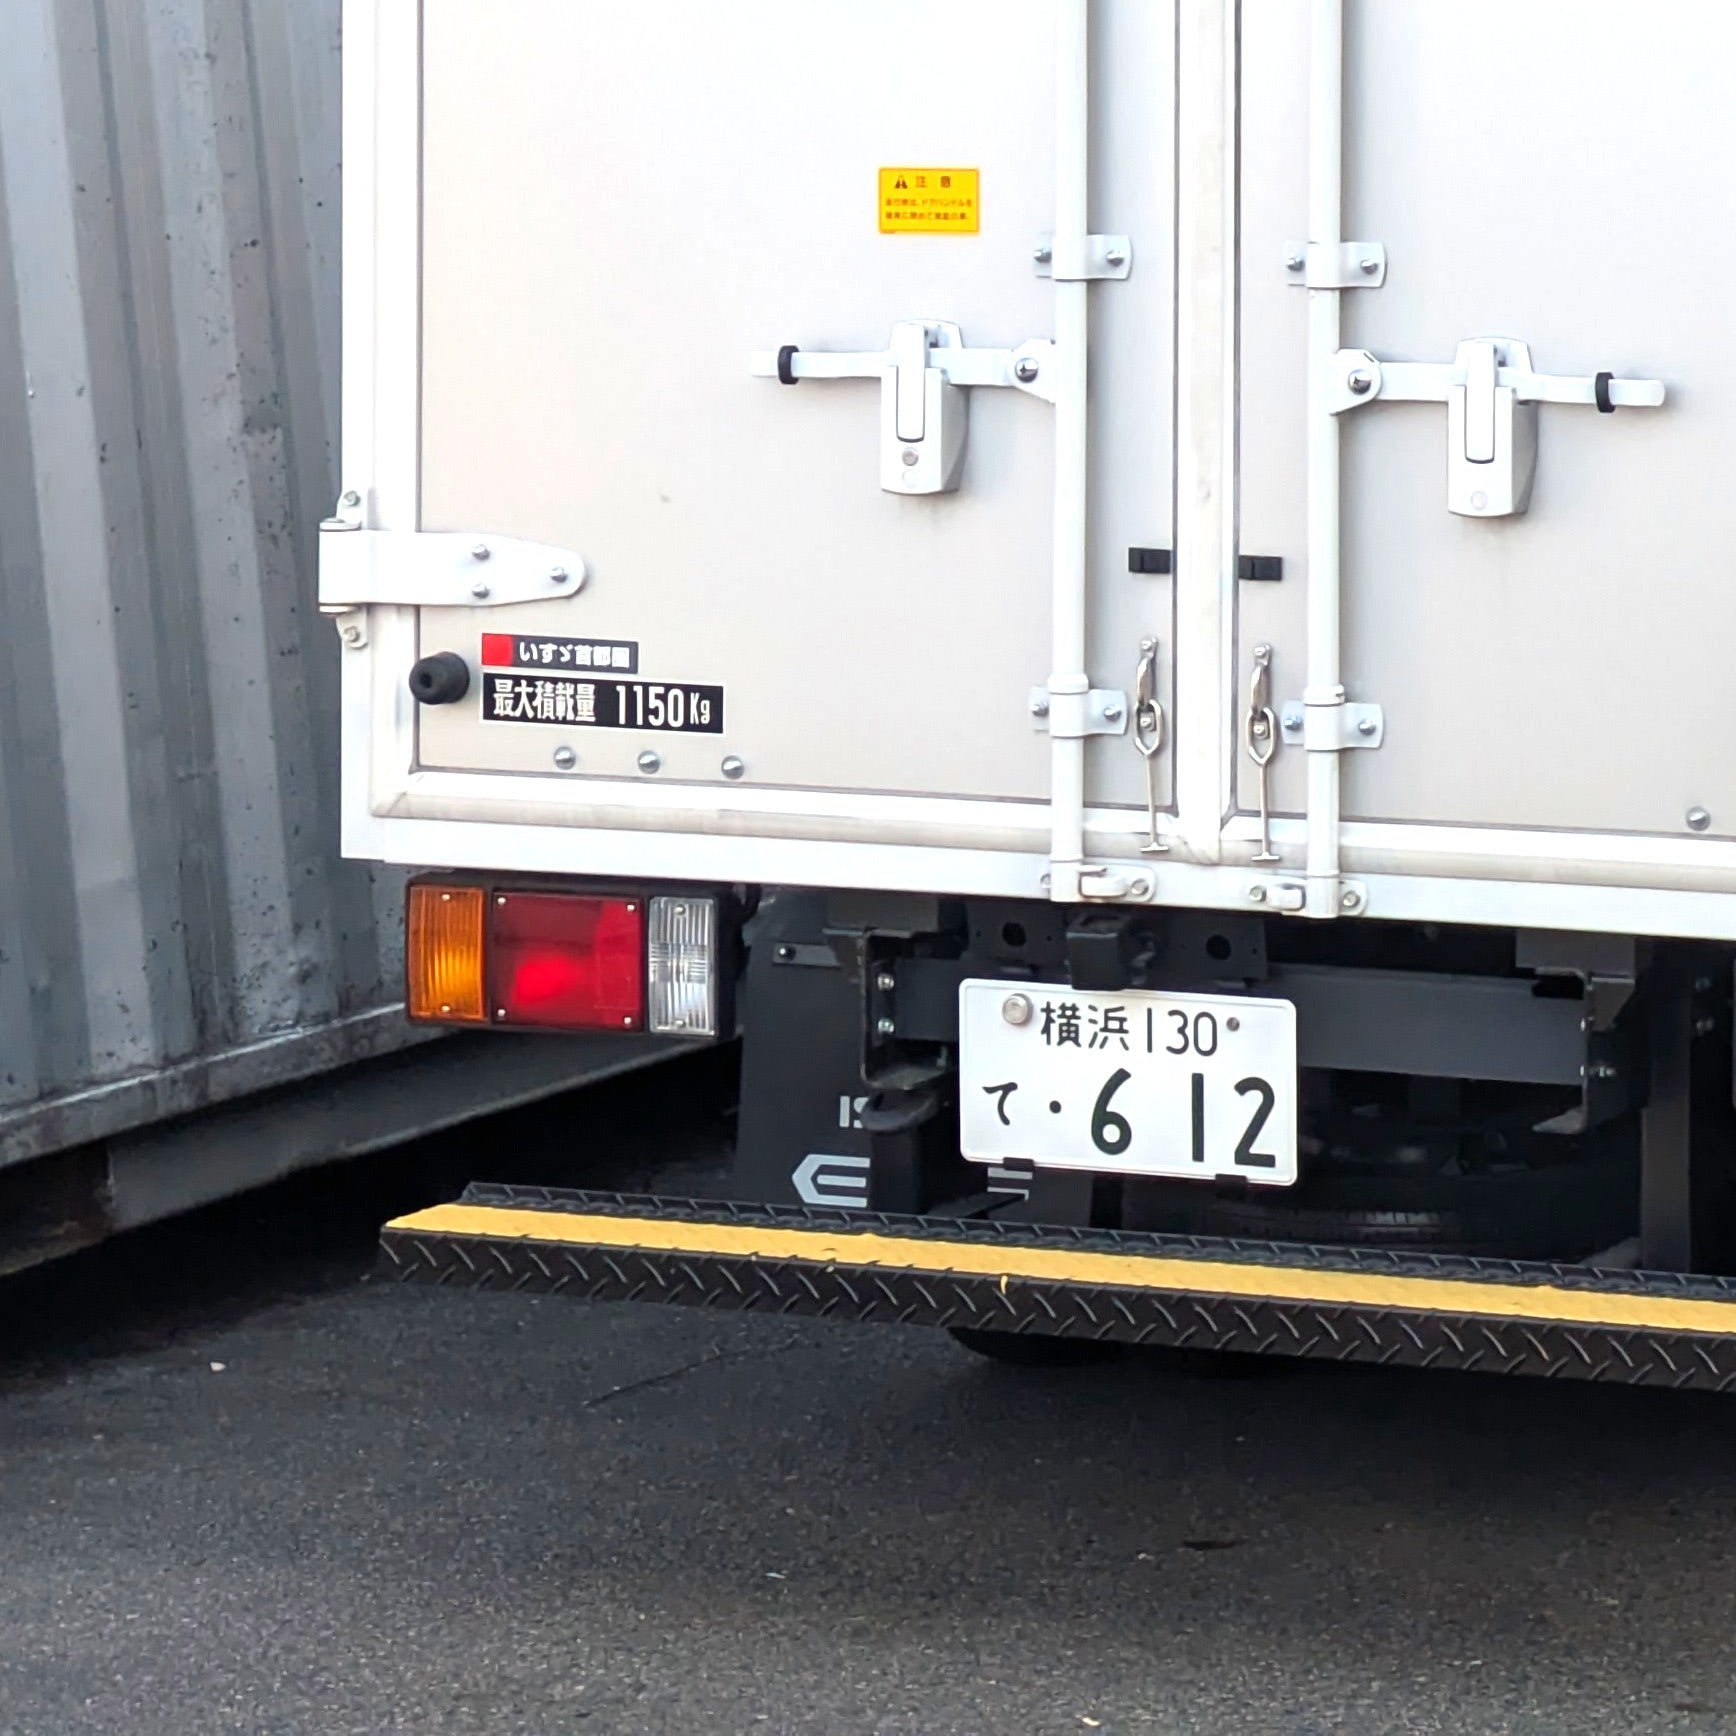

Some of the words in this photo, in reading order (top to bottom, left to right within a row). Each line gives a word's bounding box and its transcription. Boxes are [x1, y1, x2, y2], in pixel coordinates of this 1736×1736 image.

[492, 678, 597, 723] 最大積載量
[1040, 1000, 1130, 1052] 横浜
[1146, 1007, 1218, 1057] 130
[981, 1081, 1019, 1127] て
